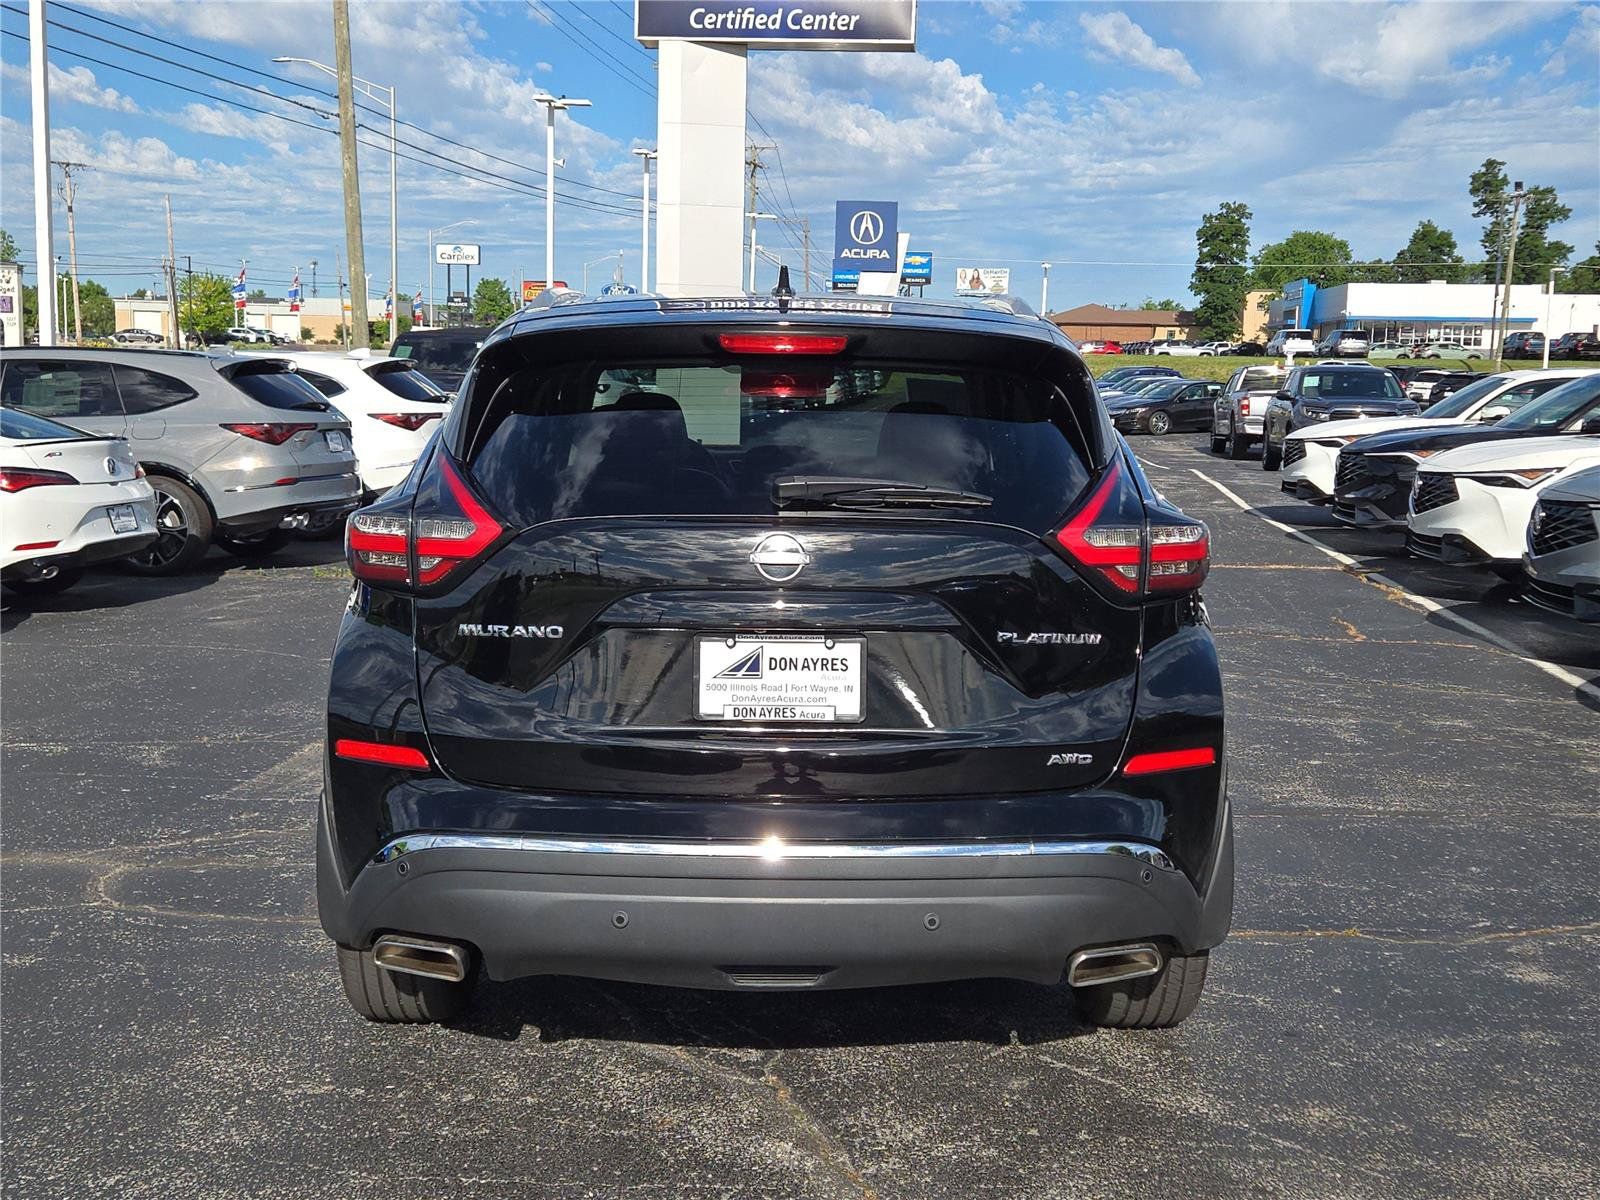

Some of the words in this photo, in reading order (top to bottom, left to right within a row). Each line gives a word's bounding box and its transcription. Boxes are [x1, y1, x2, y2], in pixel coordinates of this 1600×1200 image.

[689, 7, 782, 30] Certified
[786, 10, 860, 31] Center
[439, 252, 475, 262] Carplex
[840, 248, 890, 259] ACURA
[457, 623, 564, 639] MURANO
[996, 630, 1102, 645] PLATINUM
[768, 656, 798, 672] DON
[801, 657, 849, 673] AYRES
[705, 683, 728, 692] 5000
[730, 683, 758, 692] Illinois
[760, 683, 783, 693] Road
[791, 684, 808, 693] Fort
[843, 685, 854, 693] IN
[731, 694, 827, 704] DonAyresAcura.com
[733, 706, 757, 719] DON
[759, 706, 797, 719] AYRES
[799, 710, 826, 719] Acura
[1046, 752, 1093, 766] AWD
